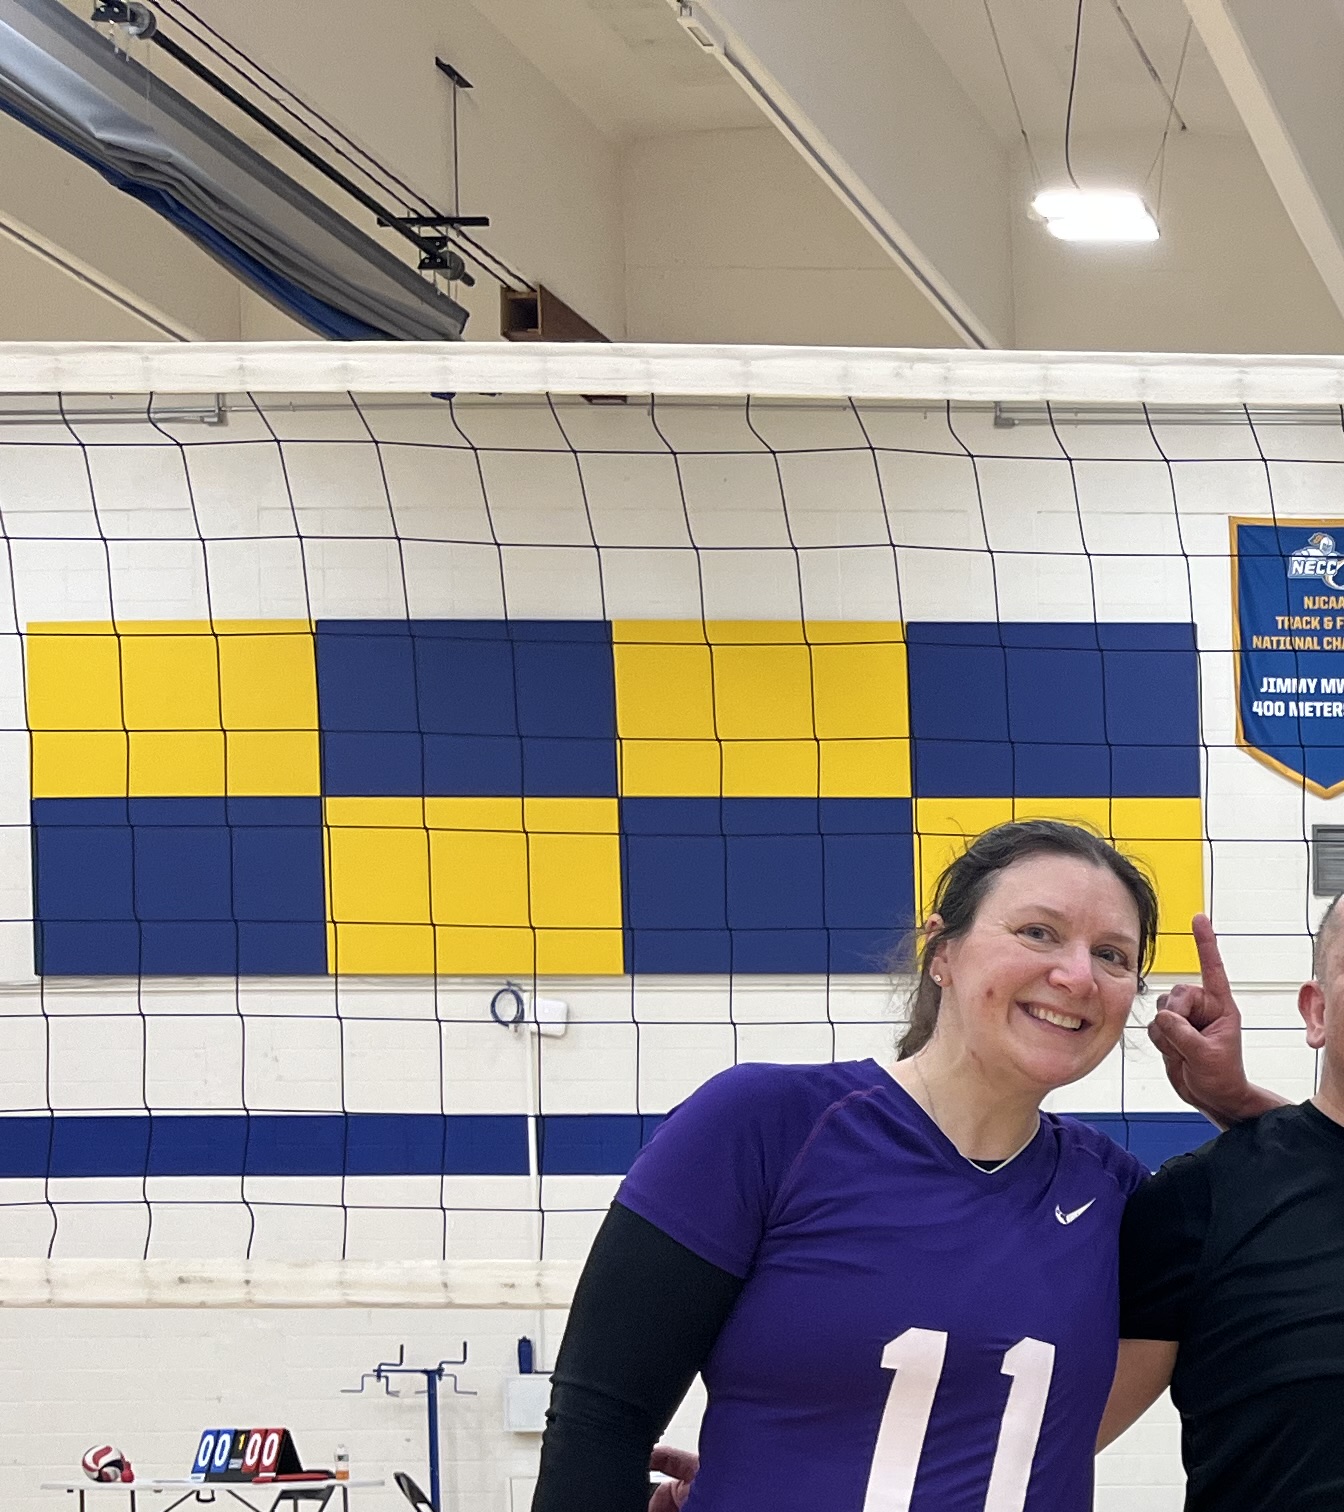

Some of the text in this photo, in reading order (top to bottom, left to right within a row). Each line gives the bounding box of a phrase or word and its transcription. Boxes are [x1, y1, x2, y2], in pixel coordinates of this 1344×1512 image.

[1292, 560, 1338, 575] NECC
[1276, 616, 1320, 630] TRACK
[1323, 616, 1332, 630] &
[1252, 636, 1321, 650] NATIONAL
[1260, 678, 1316, 693] JIMMY
[1252, 701, 1285, 717] 400
